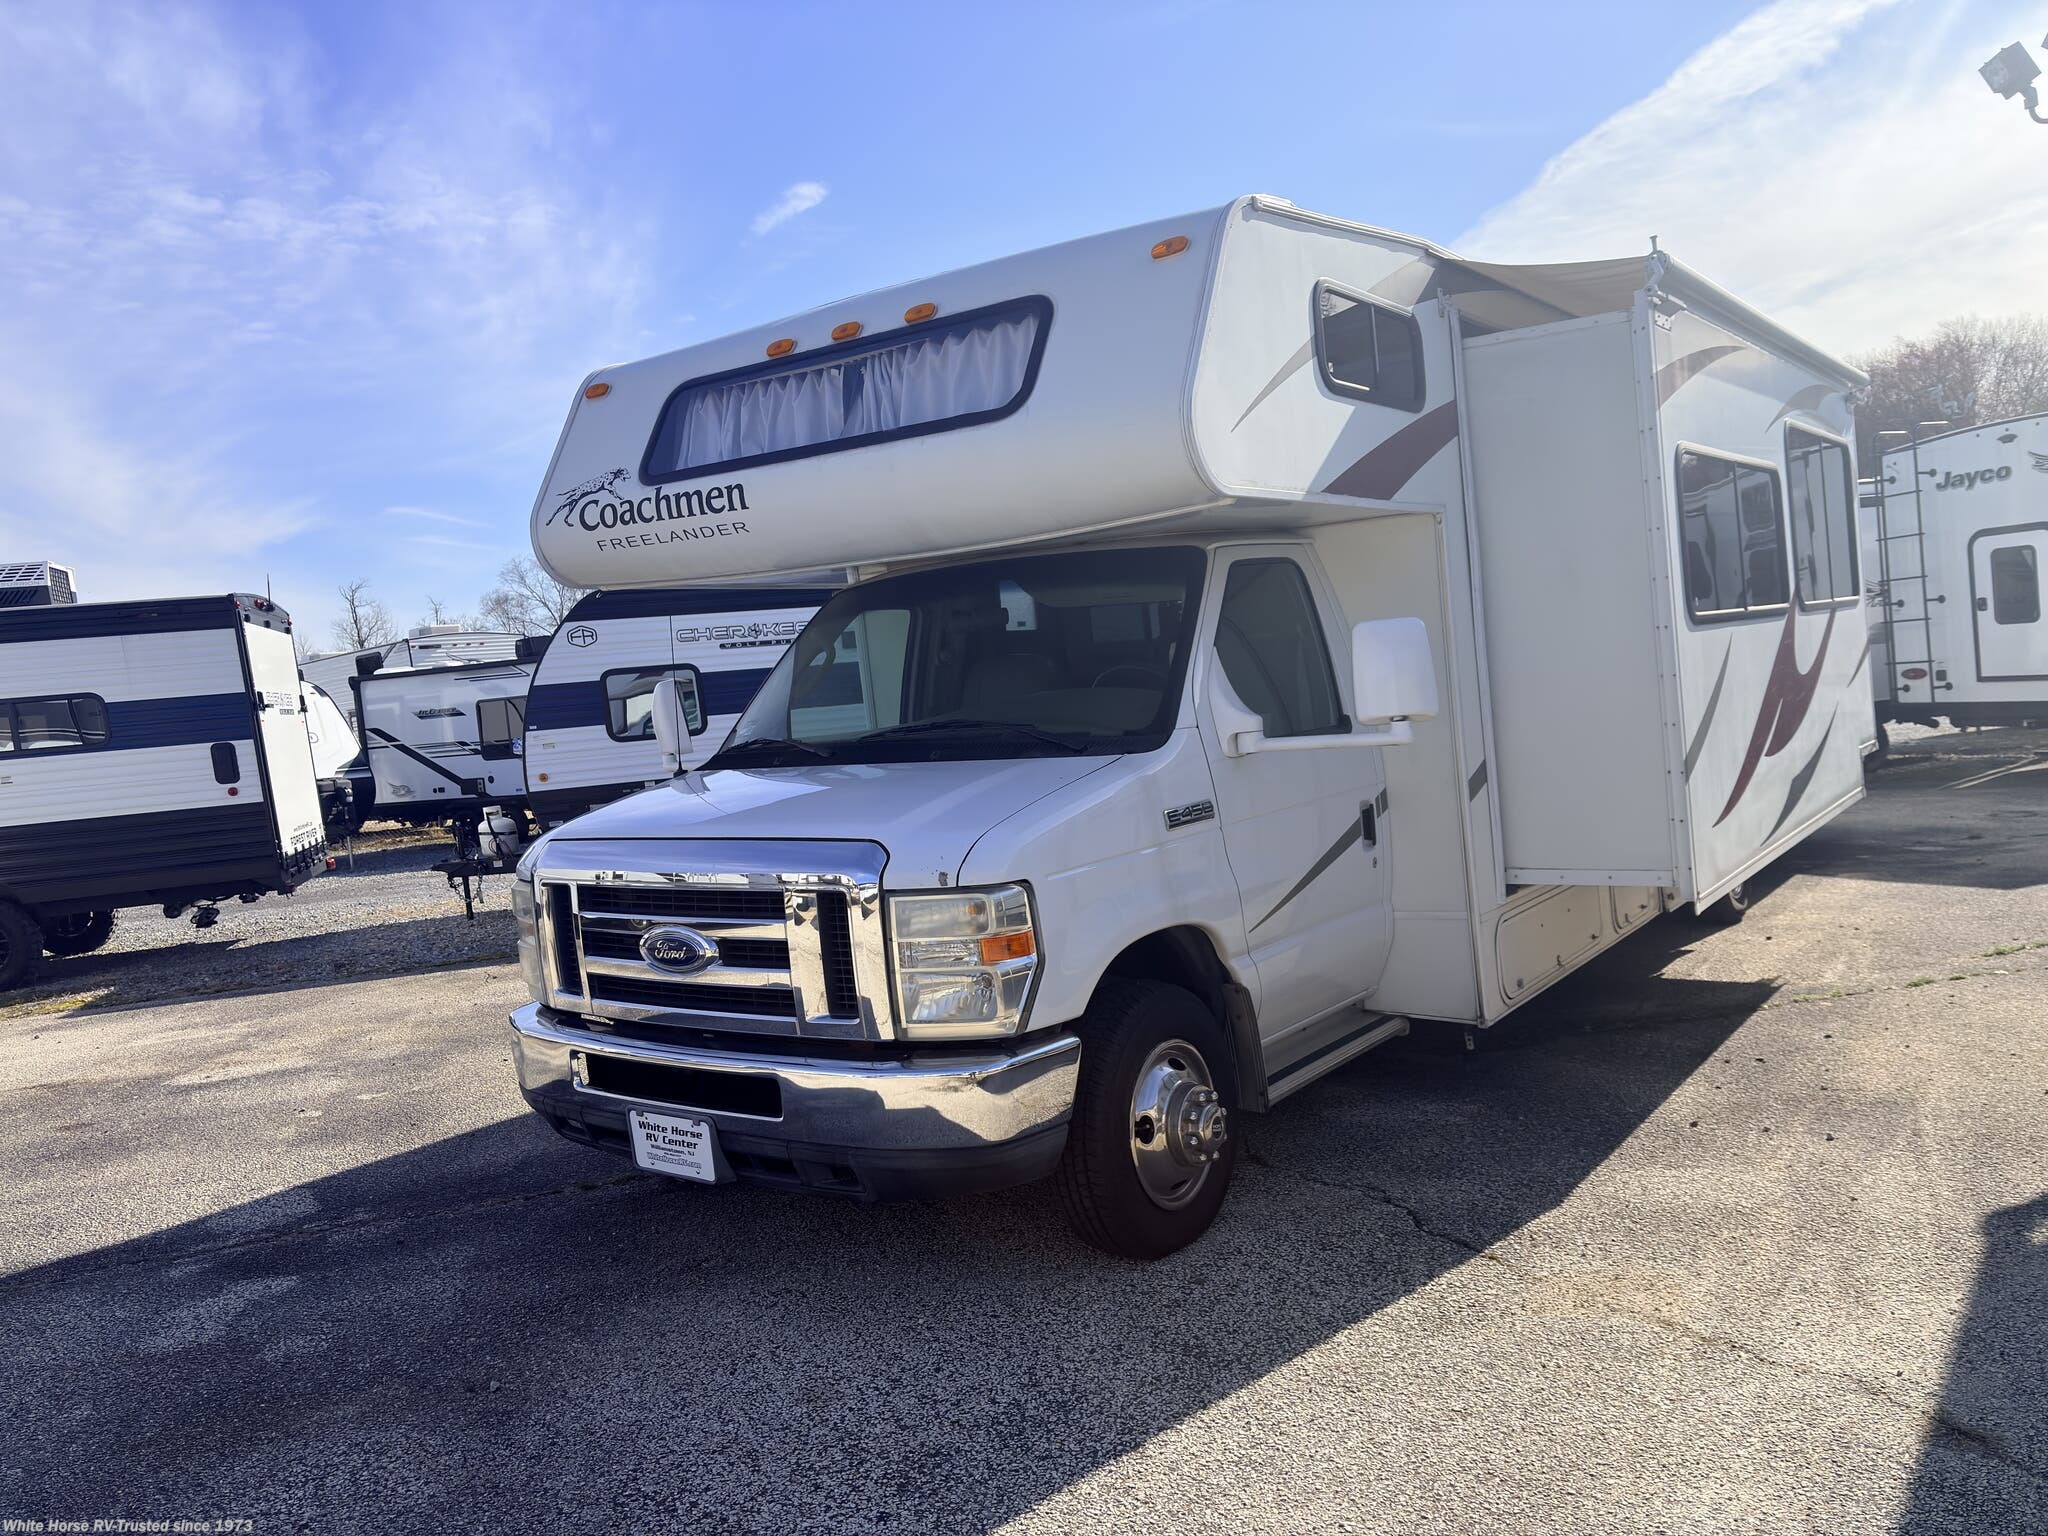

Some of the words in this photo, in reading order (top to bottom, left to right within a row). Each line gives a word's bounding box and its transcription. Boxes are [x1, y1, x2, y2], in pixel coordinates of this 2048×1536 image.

[1935, 465, 2013, 492] Jayco
[579, 483, 750, 532] Coachmen
[596, 521, 750, 552] FREELANDER
[724, 641, 761, 650] WOLF
[654, 940, 687, 960] Ford
[637, 1120, 668, 1134] White
[671, 1125, 703, 1140] Horse
[646, 1132, 660, 1143] RV
[662, 1135, 698, 1150] Center
